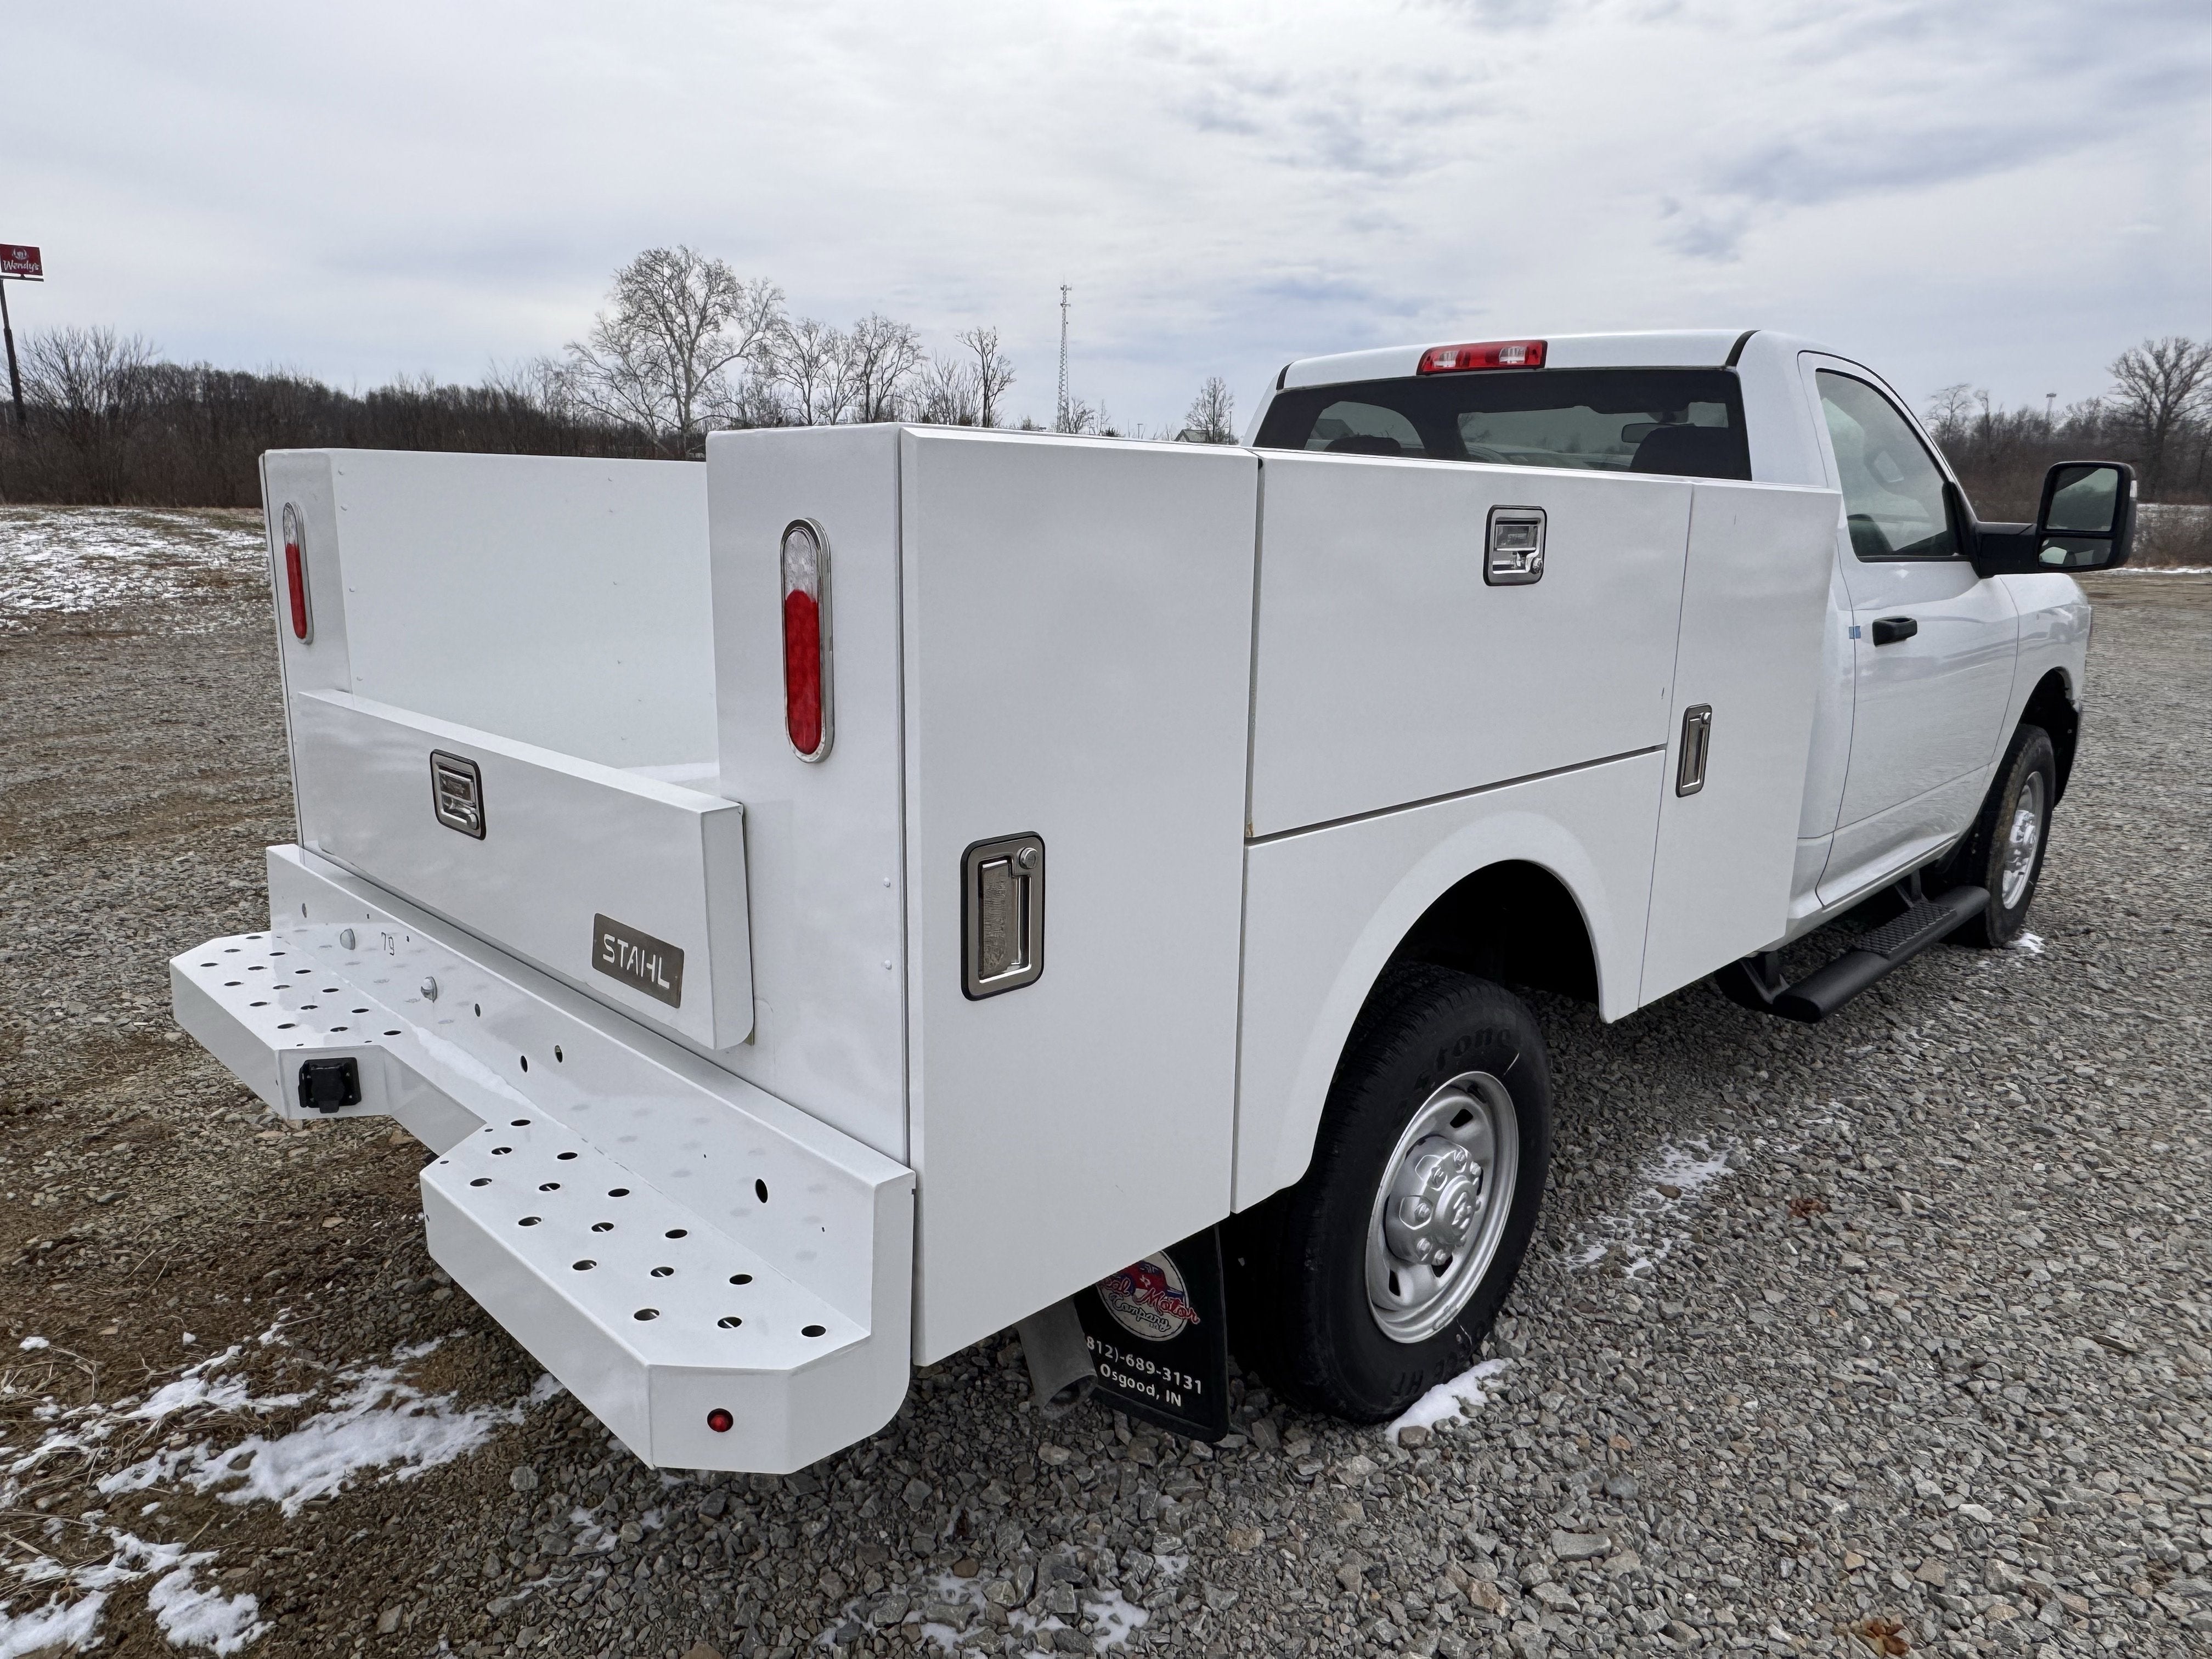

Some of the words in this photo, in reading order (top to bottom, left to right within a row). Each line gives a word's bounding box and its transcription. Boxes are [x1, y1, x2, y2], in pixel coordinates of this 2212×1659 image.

[3, 259, 40, 273] Wendy's
[602, 933, 670, 990] STAHL
[1108, 1292, 1171, 1332] Company
[1132, 1288, 1200, 1325] Motor
[1086, 1336, 1201, 1394] 812)-689-3131
[1100, 1363, 1160, 1400] Osgood,
[1166, 1390, 1181, 1407] IN
